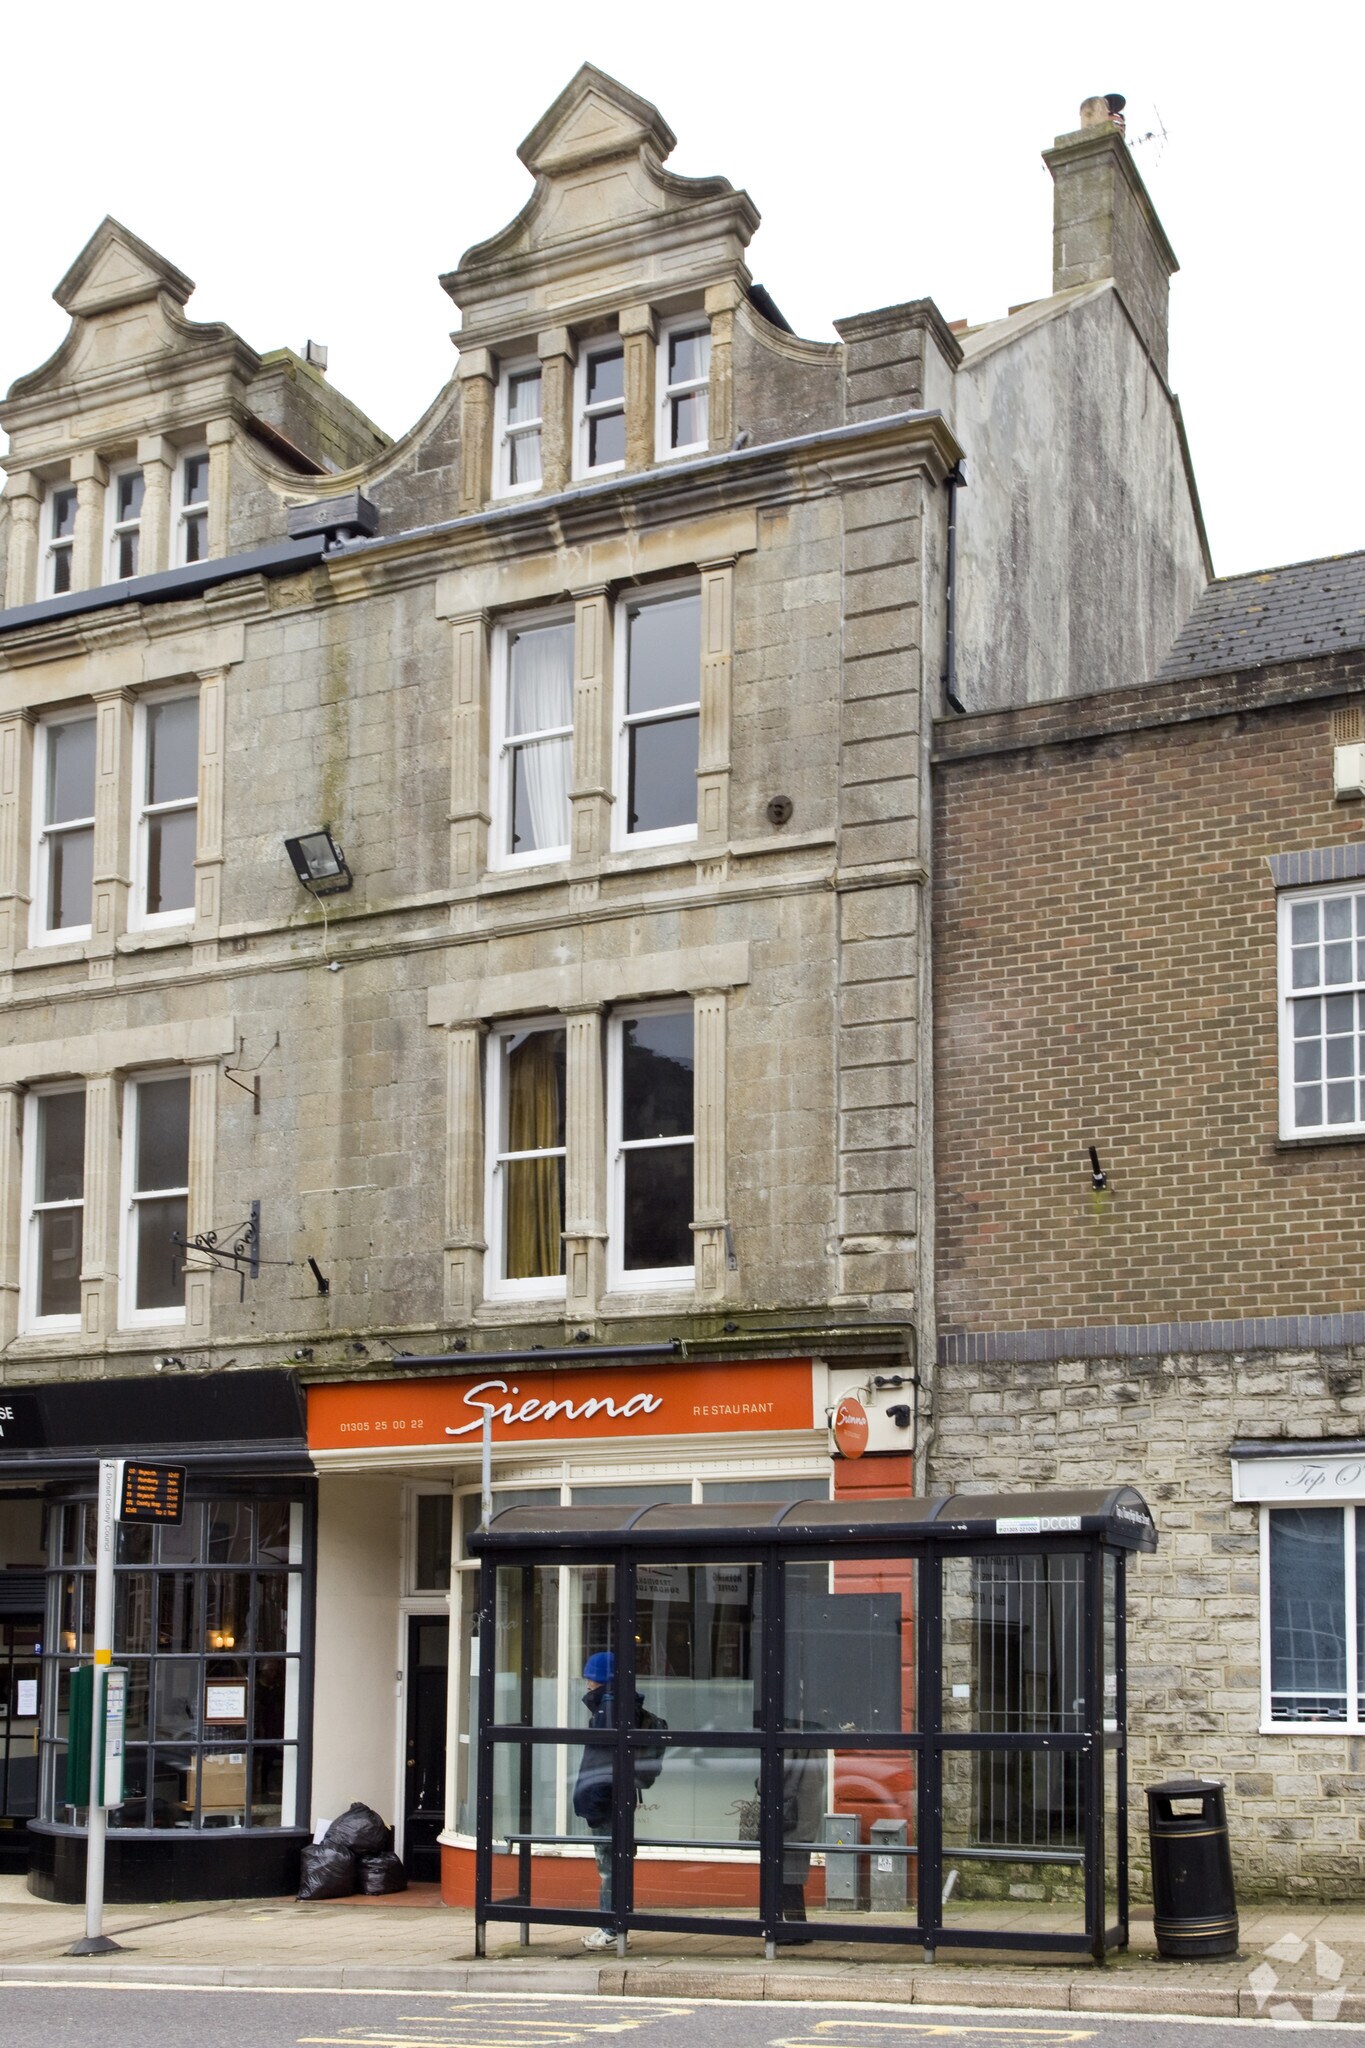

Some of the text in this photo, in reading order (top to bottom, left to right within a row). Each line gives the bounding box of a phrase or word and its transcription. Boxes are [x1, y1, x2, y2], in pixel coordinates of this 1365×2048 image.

[445, 1380, 663, 1435] Sienna
[693, 1402, 773, 1416] RESTAURANT
[837, 1406, 867, 1426] Sienna
[340, 1419, 424, 1432] 01305 25 00 22
[1285, 1464, 1329, 1494] Top
[104, 1473, 113, 1552] Dorset County Council
[1041, 1517, 1079, 1530] DCC13
